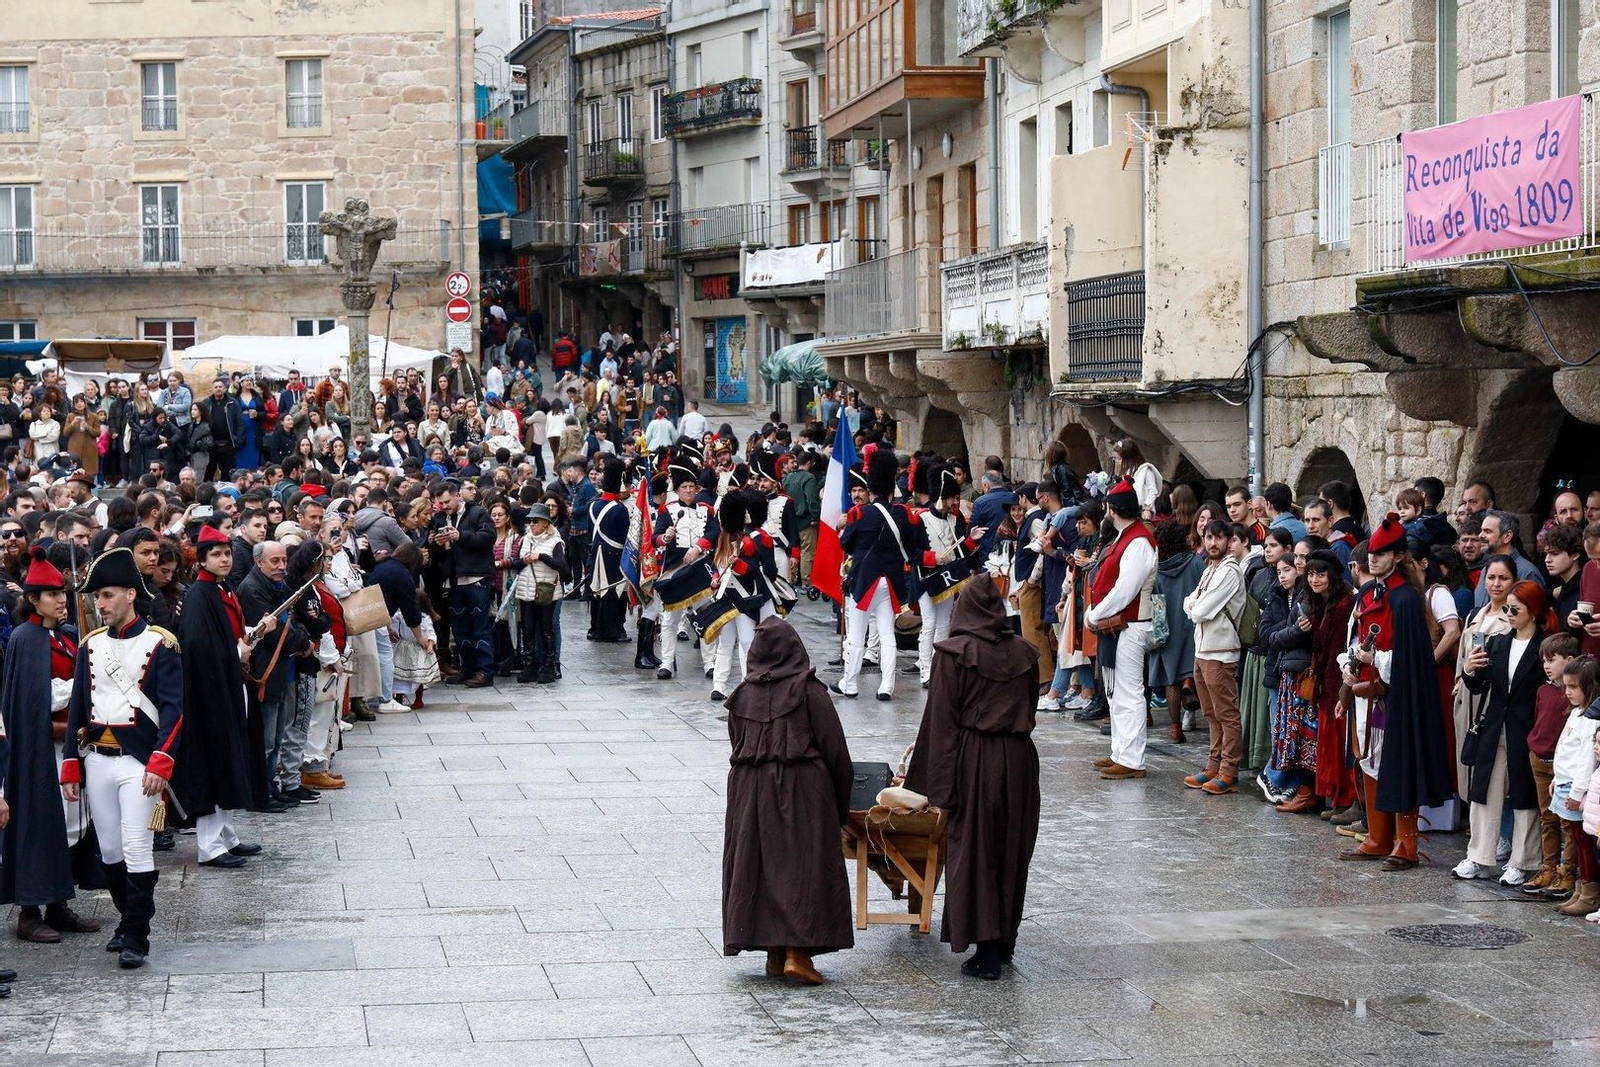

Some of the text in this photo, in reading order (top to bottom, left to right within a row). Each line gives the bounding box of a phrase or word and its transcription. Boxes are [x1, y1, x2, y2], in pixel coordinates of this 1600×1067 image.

[1406, 119, 1560, 192] Reconquista da
[1407, 178, 1574, 247] Vila de Vigo 1809
[940, 570, 959, 587] R
